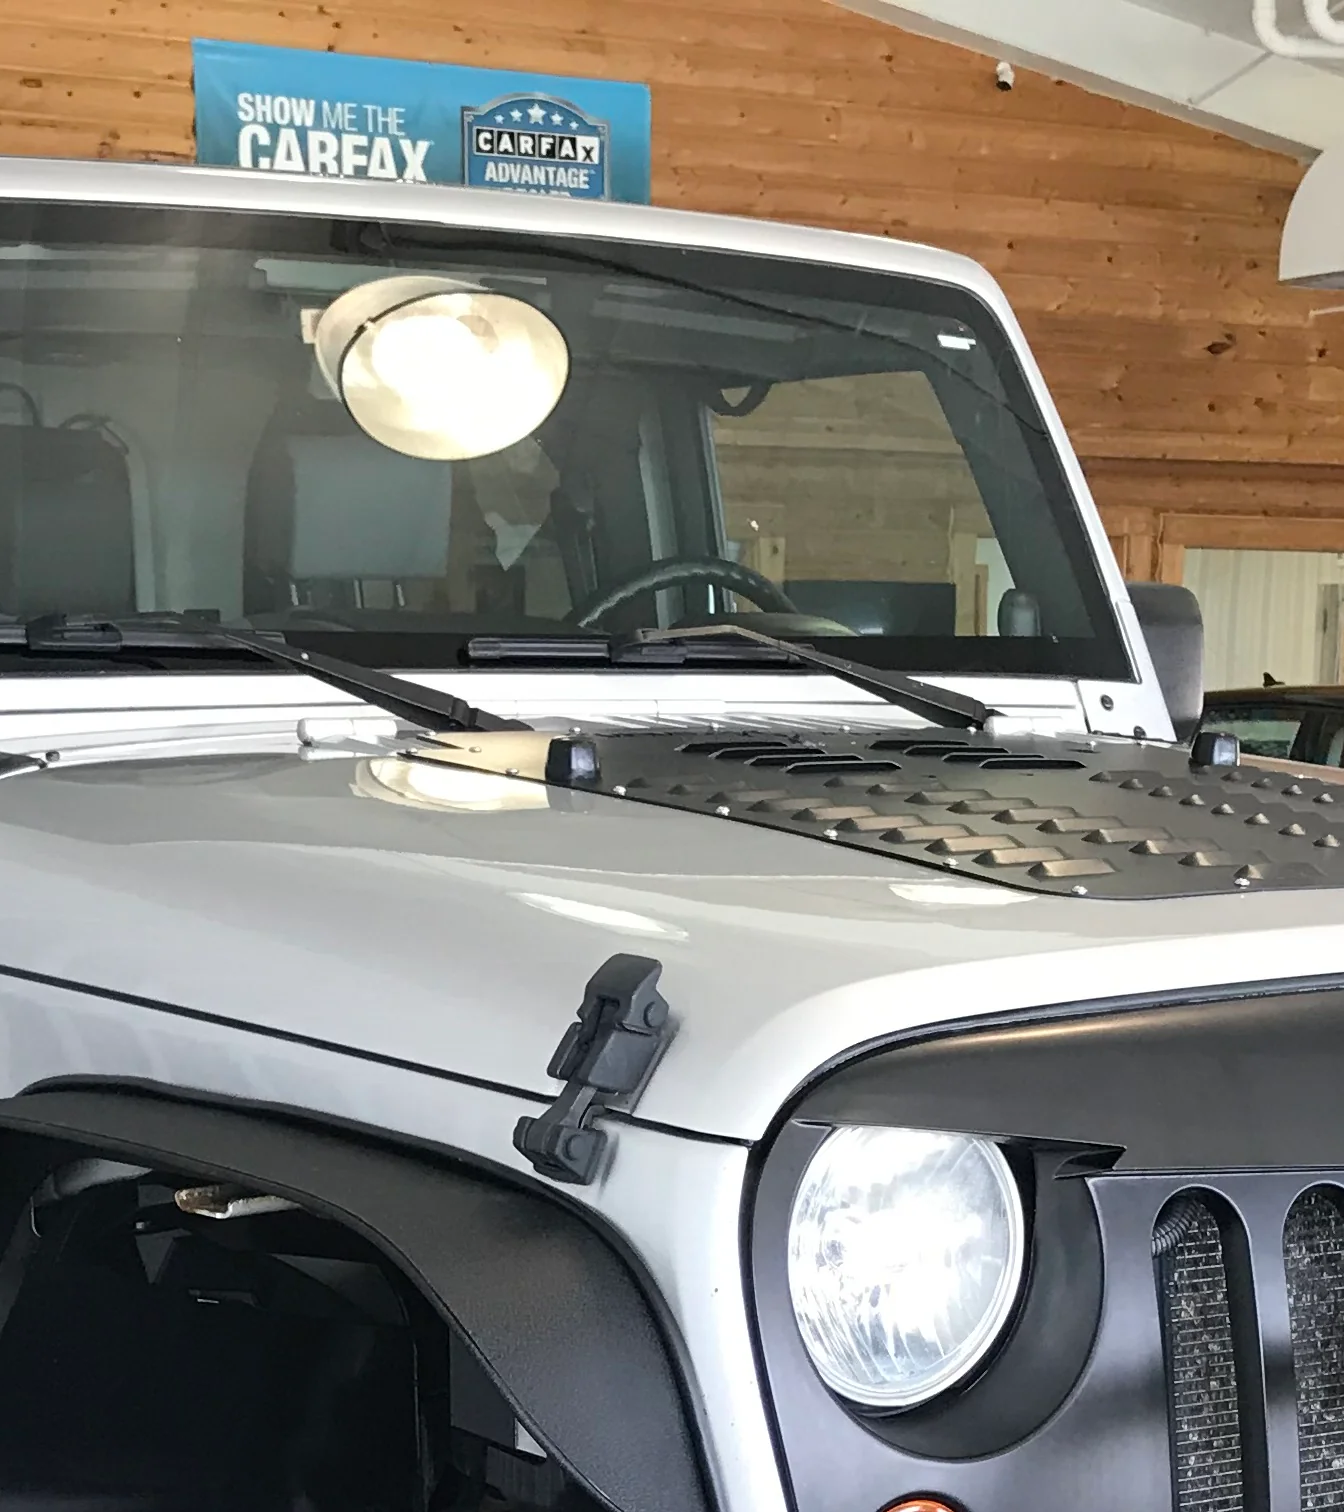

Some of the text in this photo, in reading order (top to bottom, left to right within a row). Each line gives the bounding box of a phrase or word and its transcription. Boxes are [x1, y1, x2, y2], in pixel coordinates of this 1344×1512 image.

[237, 92, 406, 136] SHOW ME THE
[238, 124, 431, 182] CARFAX
[477, 131, 595, 163] CARFAX
[484, 161, 590, 189] ADVANTAGE
